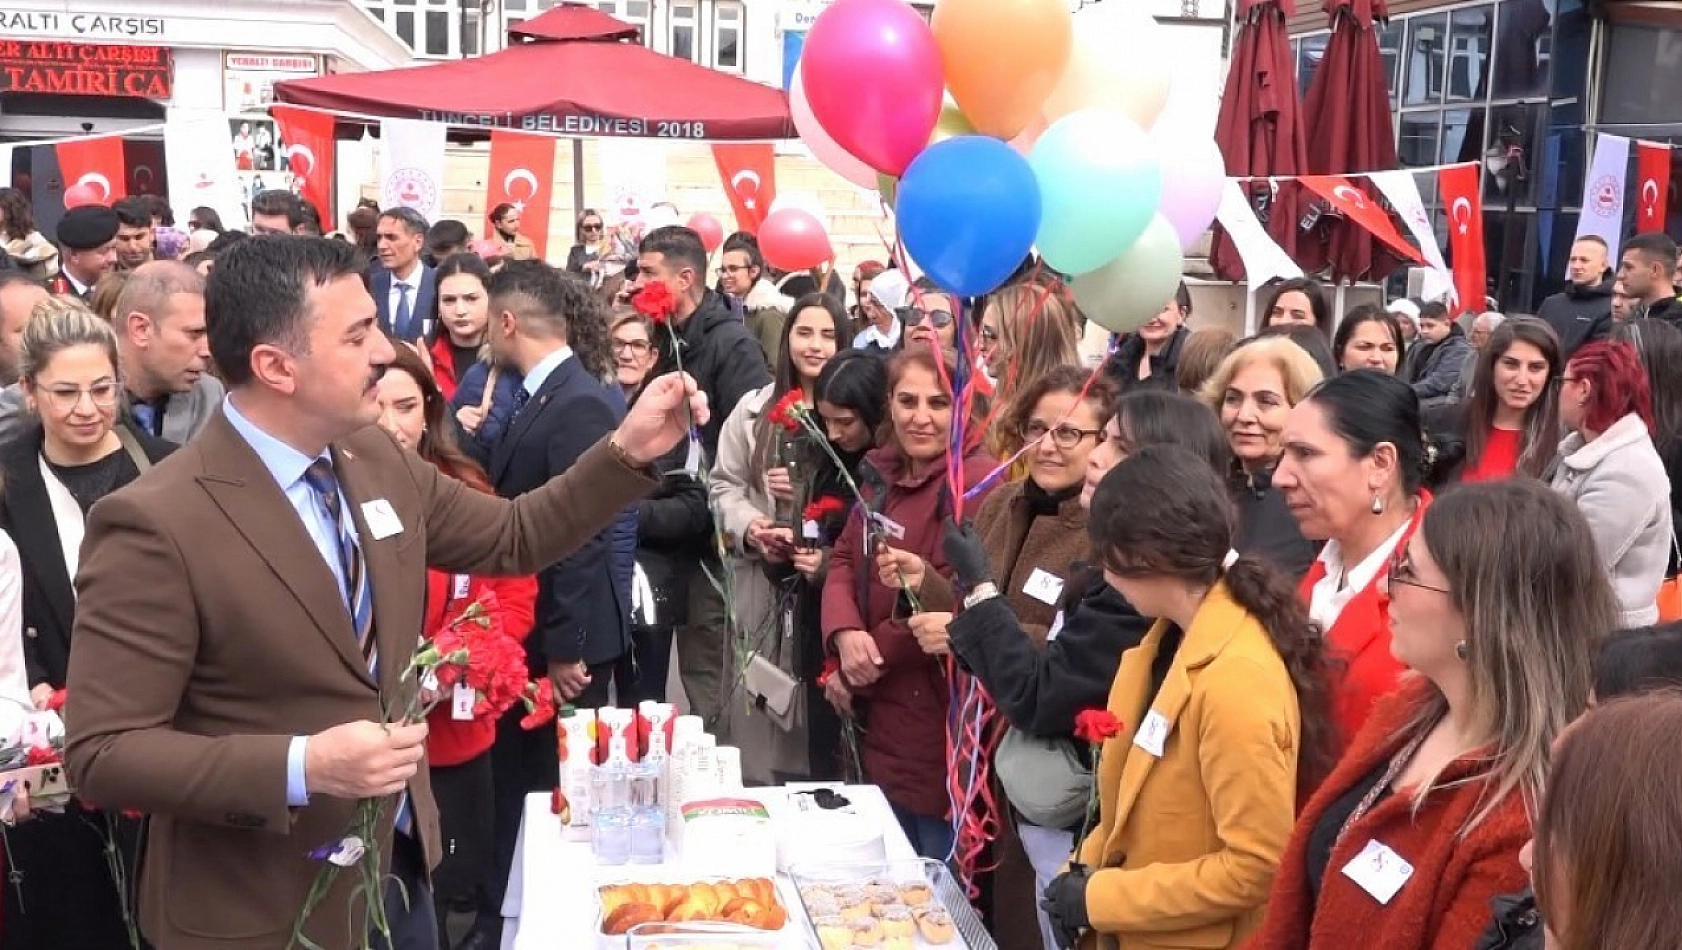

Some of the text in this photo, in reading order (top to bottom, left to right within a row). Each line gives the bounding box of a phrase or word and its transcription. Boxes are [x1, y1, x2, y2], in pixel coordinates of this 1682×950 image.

[72, 15, 165, 35] ÇARŞISI
[521, 112, 649, 136] BELEDİYESİ
[657, 121, 704, 138] 2018
